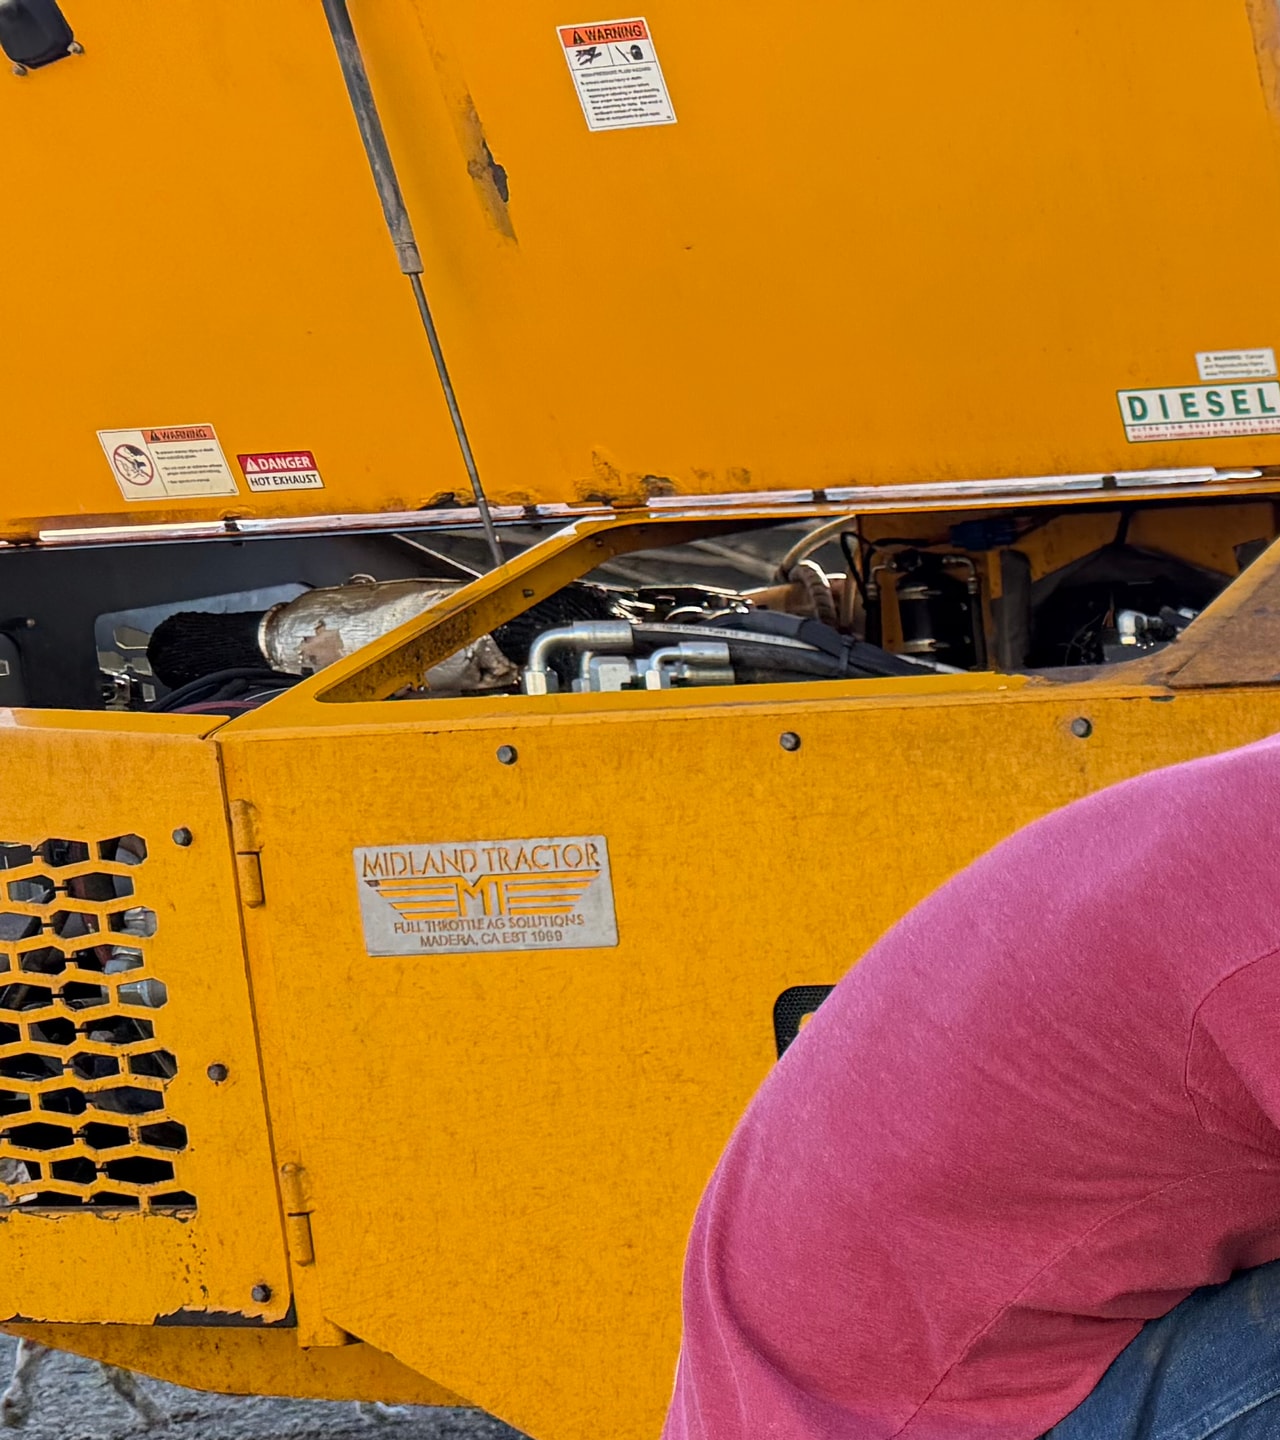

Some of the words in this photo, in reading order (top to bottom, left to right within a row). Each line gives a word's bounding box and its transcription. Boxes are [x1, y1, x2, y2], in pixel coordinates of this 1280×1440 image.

[584, 24, 643, 42] WARNING
[1127, 388, 1276, 421] DIESEL
[159, 428, 208, 441] WARNING
[257, 455, 313, 471] DANGER
[250, 475, 272, 487] HOT
[273, 473, 319, 486] EXHAUST
[362, 849, 478, 878] MIDLAND
[481, 842, 602, 873] TRACTOR
[394, 920, 422, 934] FULL
[424, 917, 485, 933] THROTTLE
[486, 917, 506, 931] AG
[508, 913, 586, 930] SOLUTIONS
[419, 932, 479, 948] MADERA,
[481, 931, 502, 944] CA
[503, 931, 527, 943] EST
